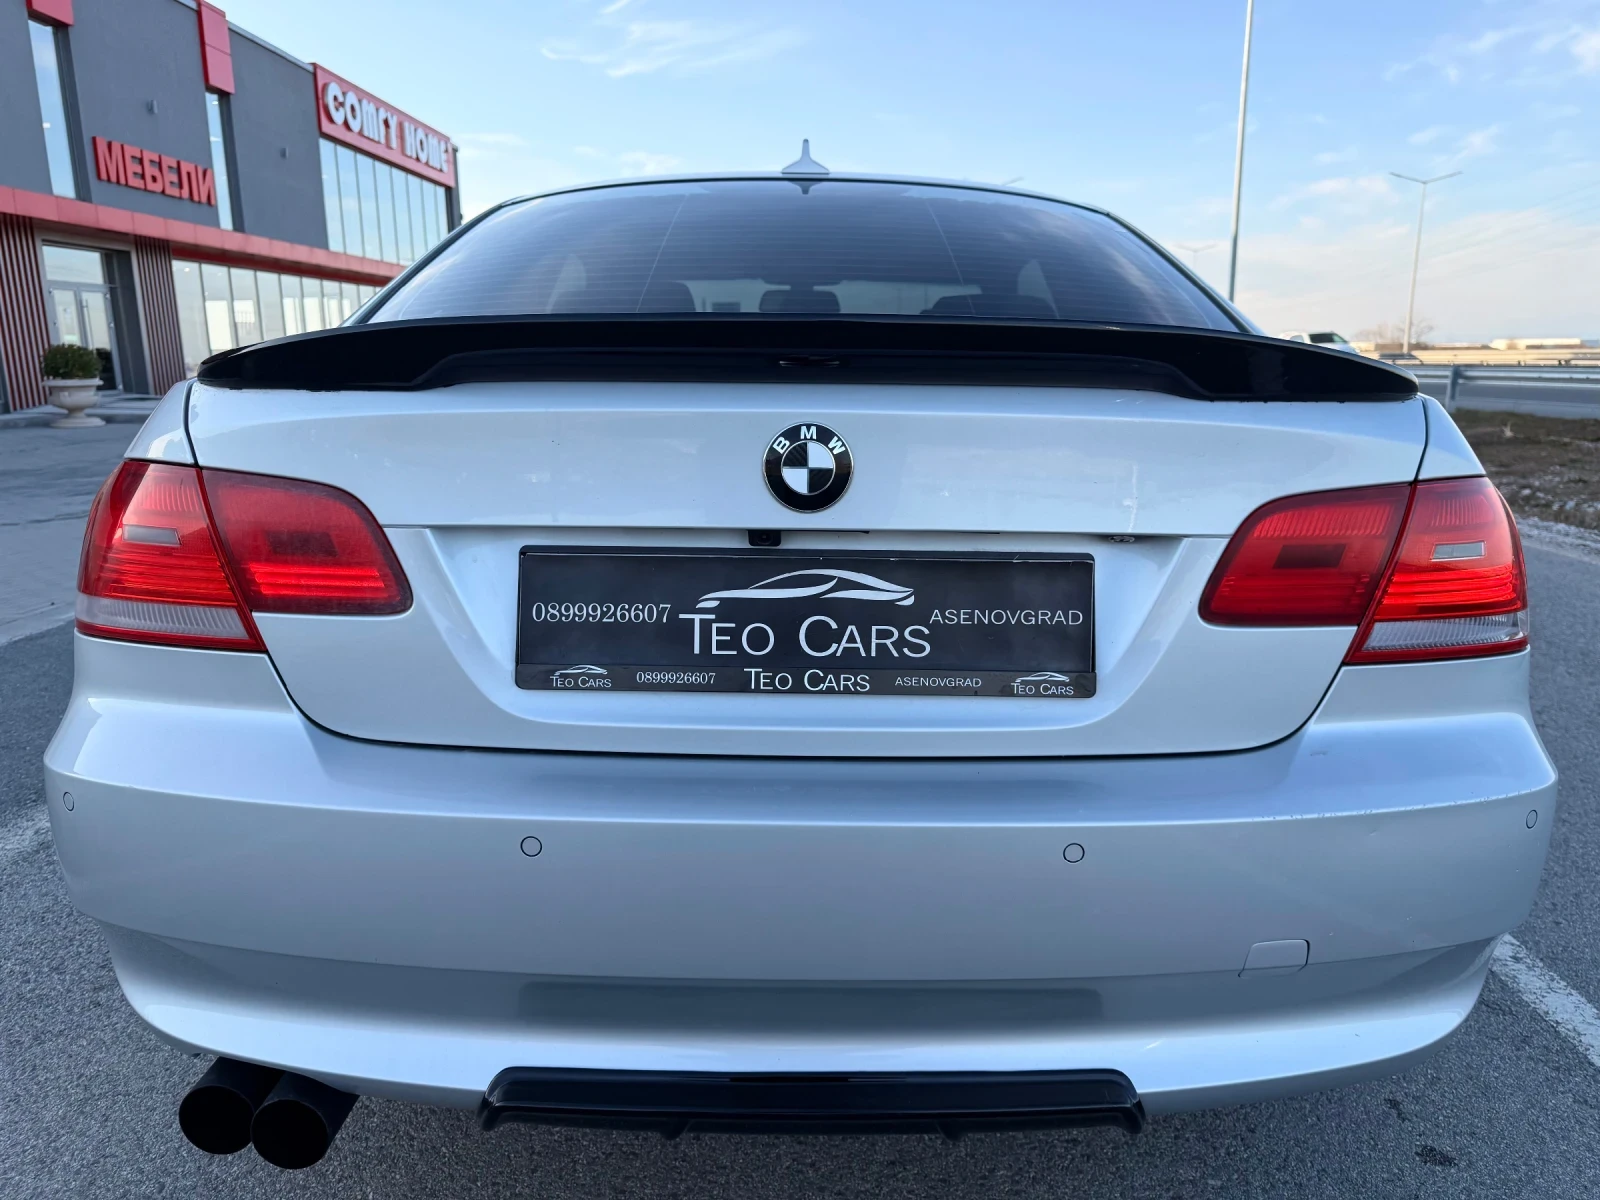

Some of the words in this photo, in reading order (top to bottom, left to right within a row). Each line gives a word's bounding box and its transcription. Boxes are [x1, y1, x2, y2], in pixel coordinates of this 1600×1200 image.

[324, 81, 399, 148] COMFY
[402, 120, 450, 173] HOME
[92, 136, 217, 207] МЕБЕЛИ
[772, 425, 846, 455] BMW
[532, 602, 671, 624] 0899926607
[929, 609, 1084, 626] ASENOVGRAD
[679, 613, 775, 656] TEO
[798, 615, 932, 659] CARS
[636, 671, 716, 685] 0899926607
[743, 668, 792, 690] TEO
[803, 669, 870, 692] CARS
[895, 676, 982, 688] ASENOVGRAD
